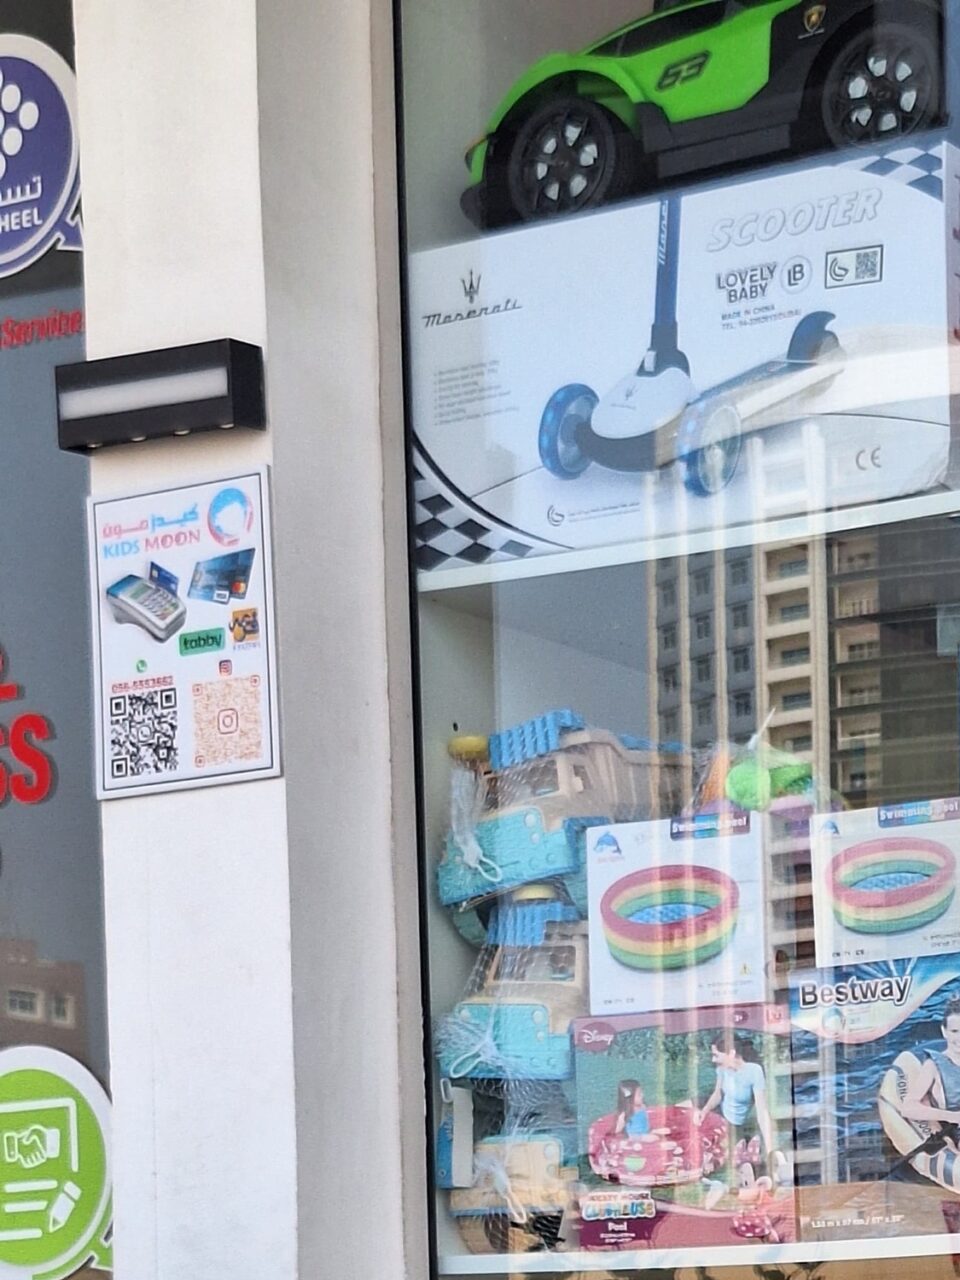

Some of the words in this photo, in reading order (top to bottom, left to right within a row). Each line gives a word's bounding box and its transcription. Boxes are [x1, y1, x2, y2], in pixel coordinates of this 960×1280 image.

[0, 175, 42, 206] تس
[706, 187, 882, 252] SCOOTER
[716, 262, 778, 290] LOVELY
[728, 282, 768, 303] BABY
[422, 298, 523, 329] Maserati
[103, 540, 140, 559] KIDS
[144, 529, 201, 551] MOON
[184, 633, 222, 651] tabby
[800, 976, 911, 1007] Bestway
[581, 1029, 614, 1045] Disney
